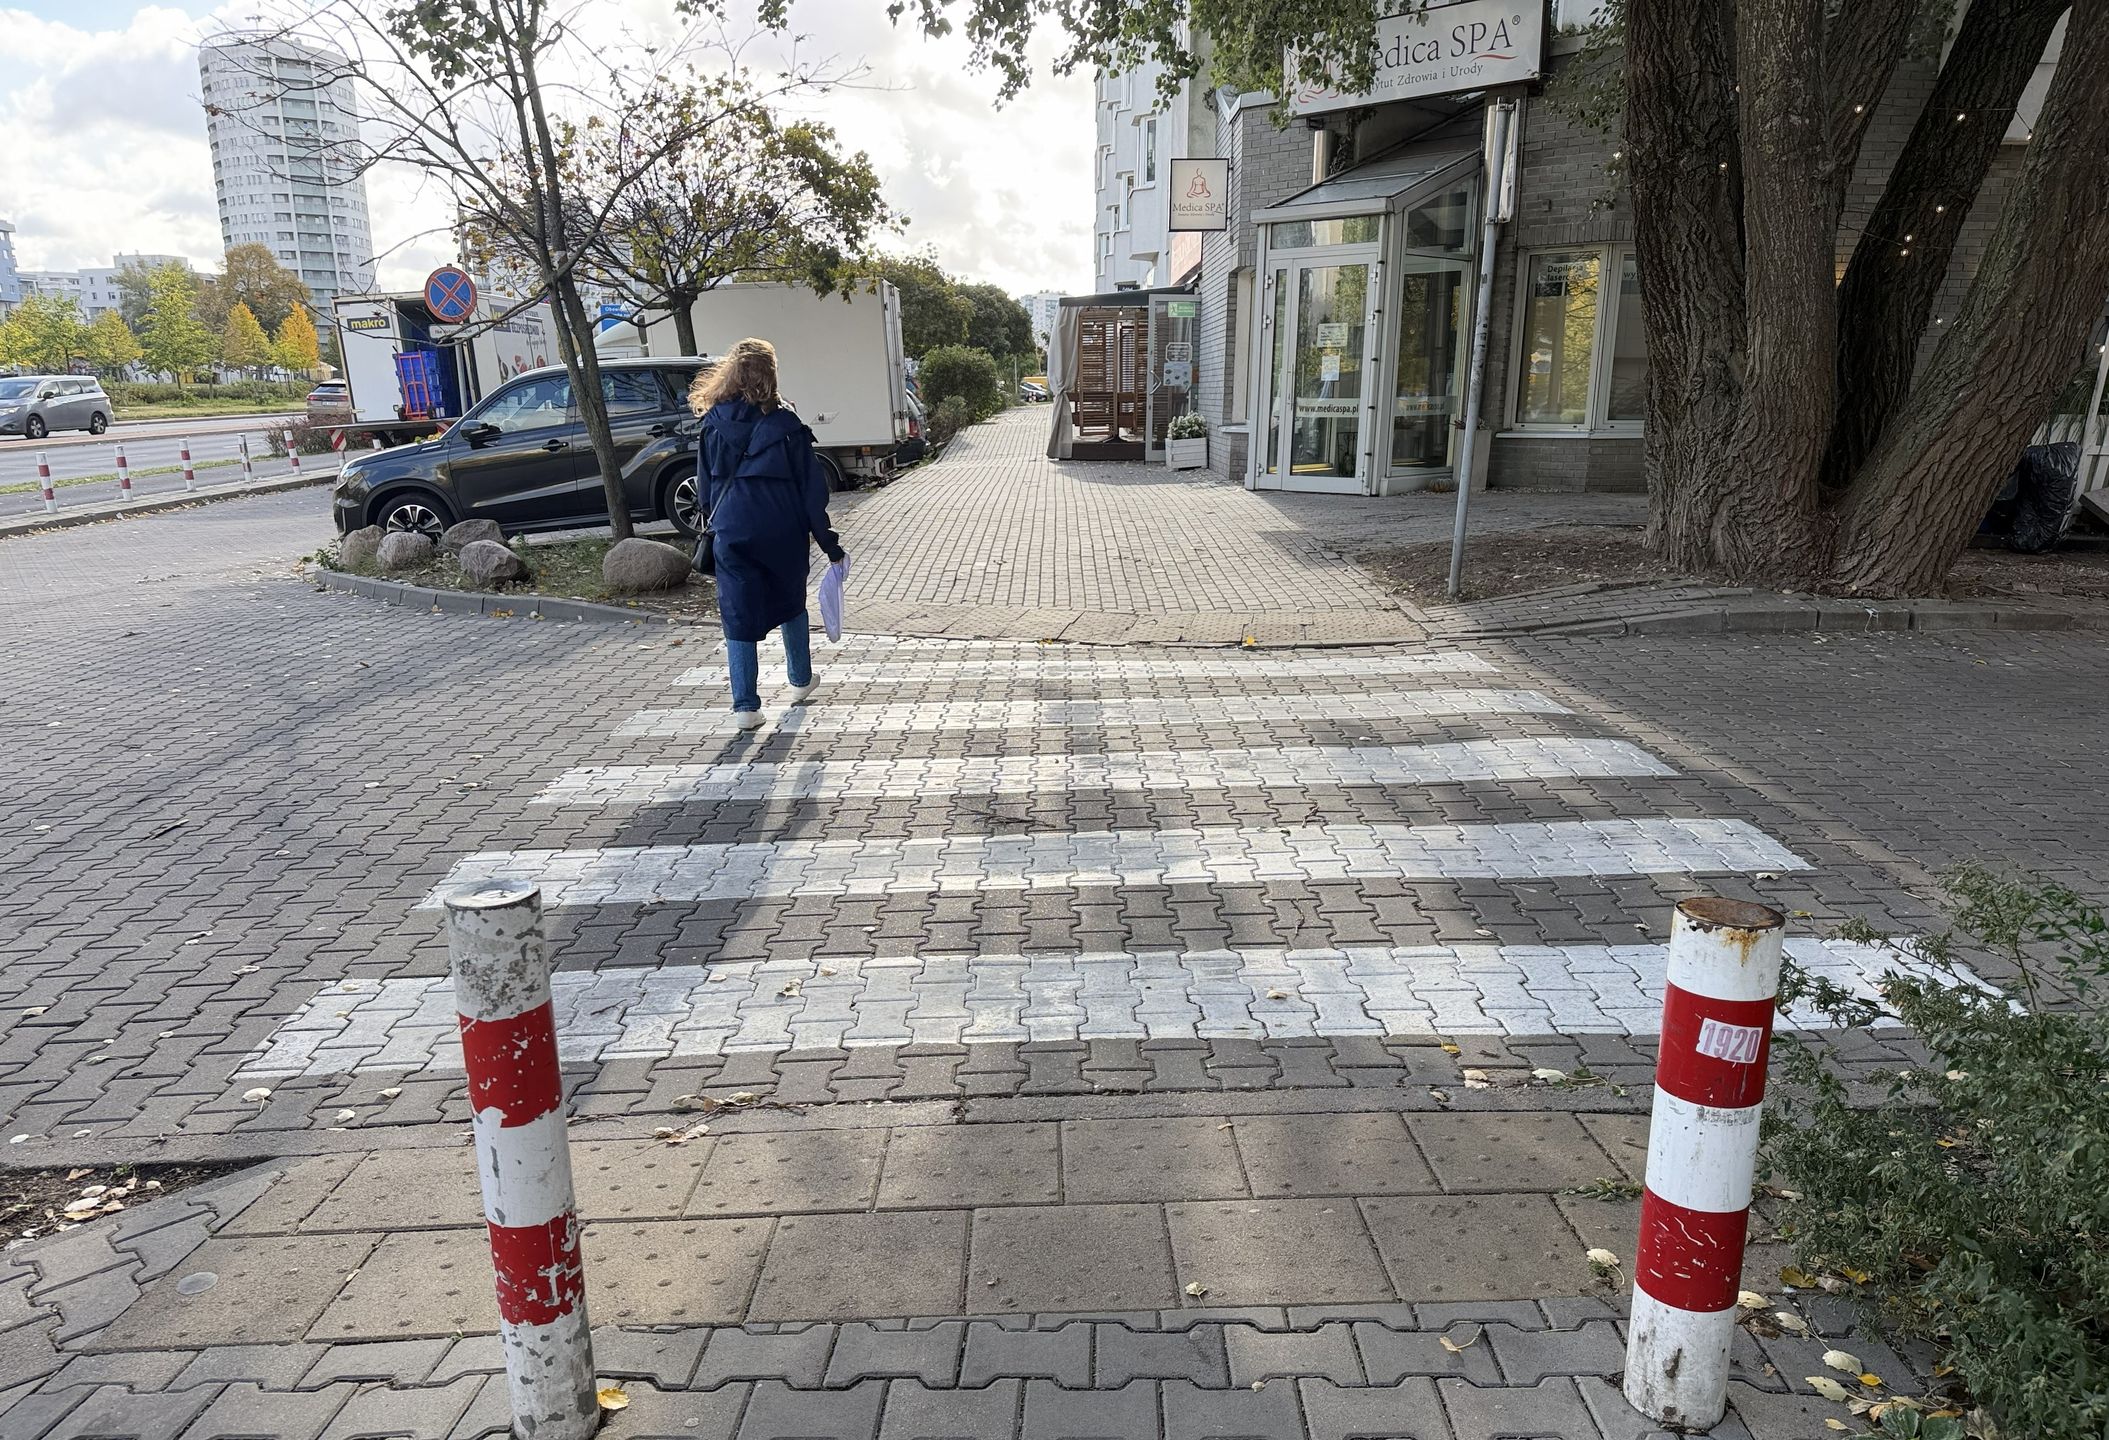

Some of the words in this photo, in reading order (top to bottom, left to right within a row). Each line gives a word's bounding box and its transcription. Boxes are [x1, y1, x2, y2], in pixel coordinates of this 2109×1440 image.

[1371, 35, 1441, 71] edica
[1397, 72, 1438, 86] Zdrowia
[1442, 70, 1446, 79] i
[1450, 63, 1484, 78] Urody
[1172, 203, 1203, 212] Medica
[350, 318, 386, 329] makro
[1299, 404, 1359, 414] www.medicaspa.pl
[1703, 1022, 1760, 1062] 1920
